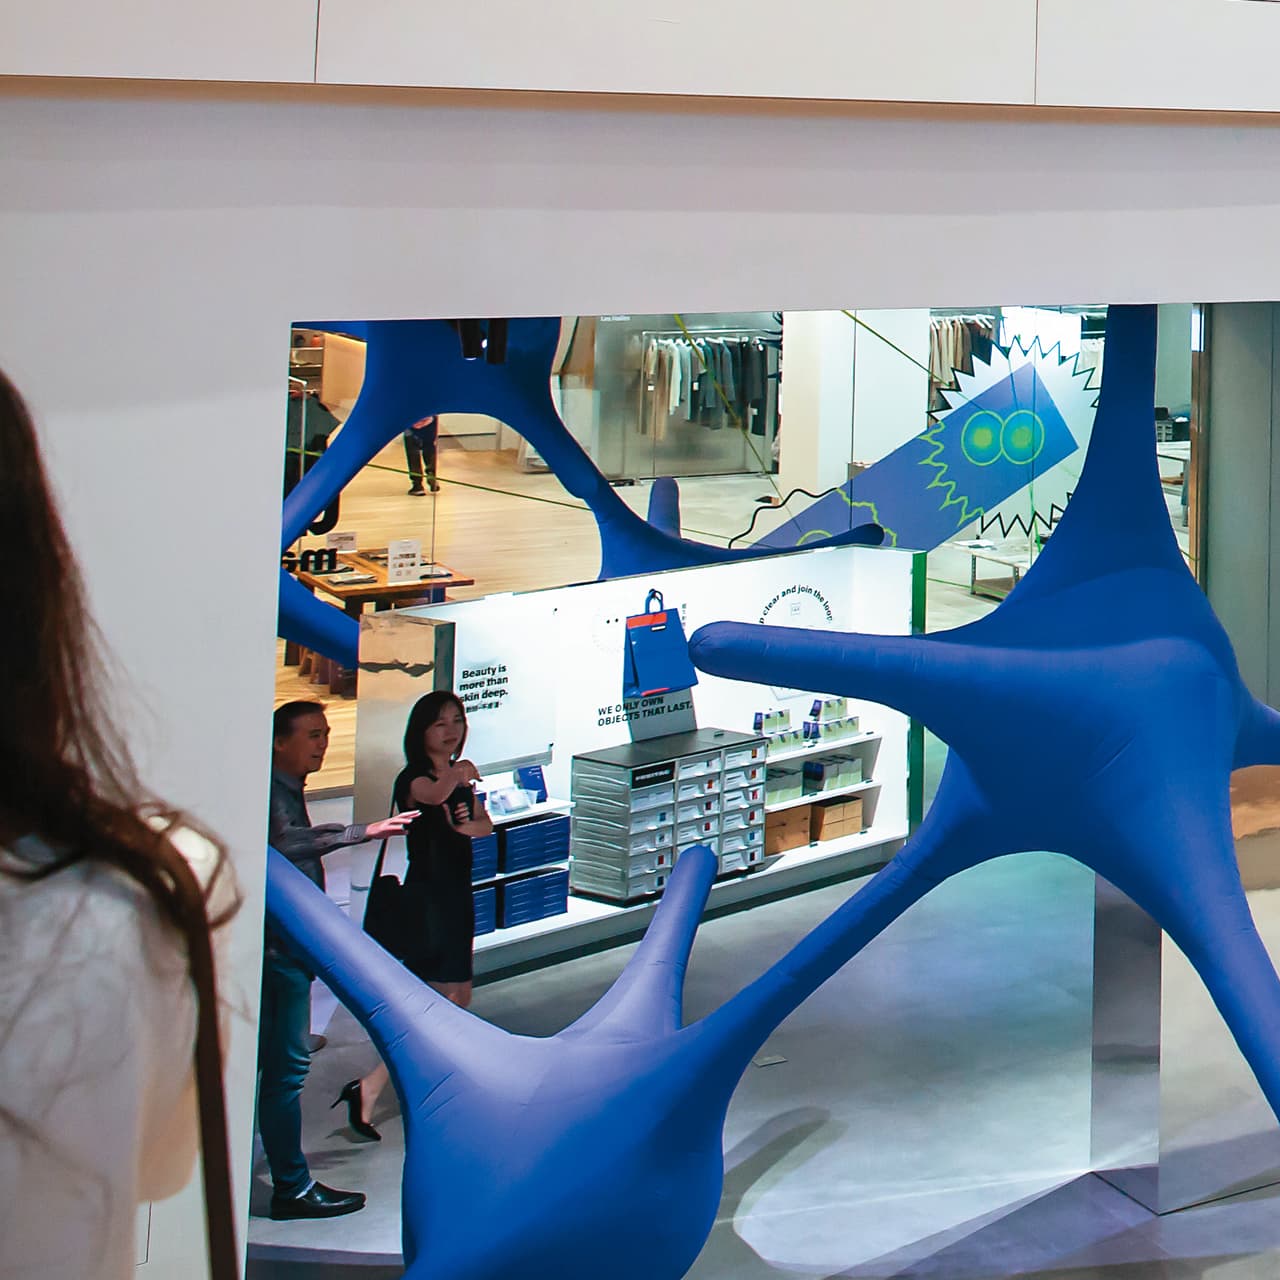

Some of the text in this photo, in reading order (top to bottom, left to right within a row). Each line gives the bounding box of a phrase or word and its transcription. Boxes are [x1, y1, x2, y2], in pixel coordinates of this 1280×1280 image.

[762, 594, 780, 616] clear
[781, 585, 796, 598] and
[797, 584, 813, 594] join
[813, 589, 825, 603] the
[462, 663, 507, 679] Beauty is
[459, 676, 508, 691] more than
[481, 689, 509, 699] deep.
[598, 696, 665, 716] WE ONLY OWN
[598, 700, 693, 727] OBJECTS THAT LAST.
